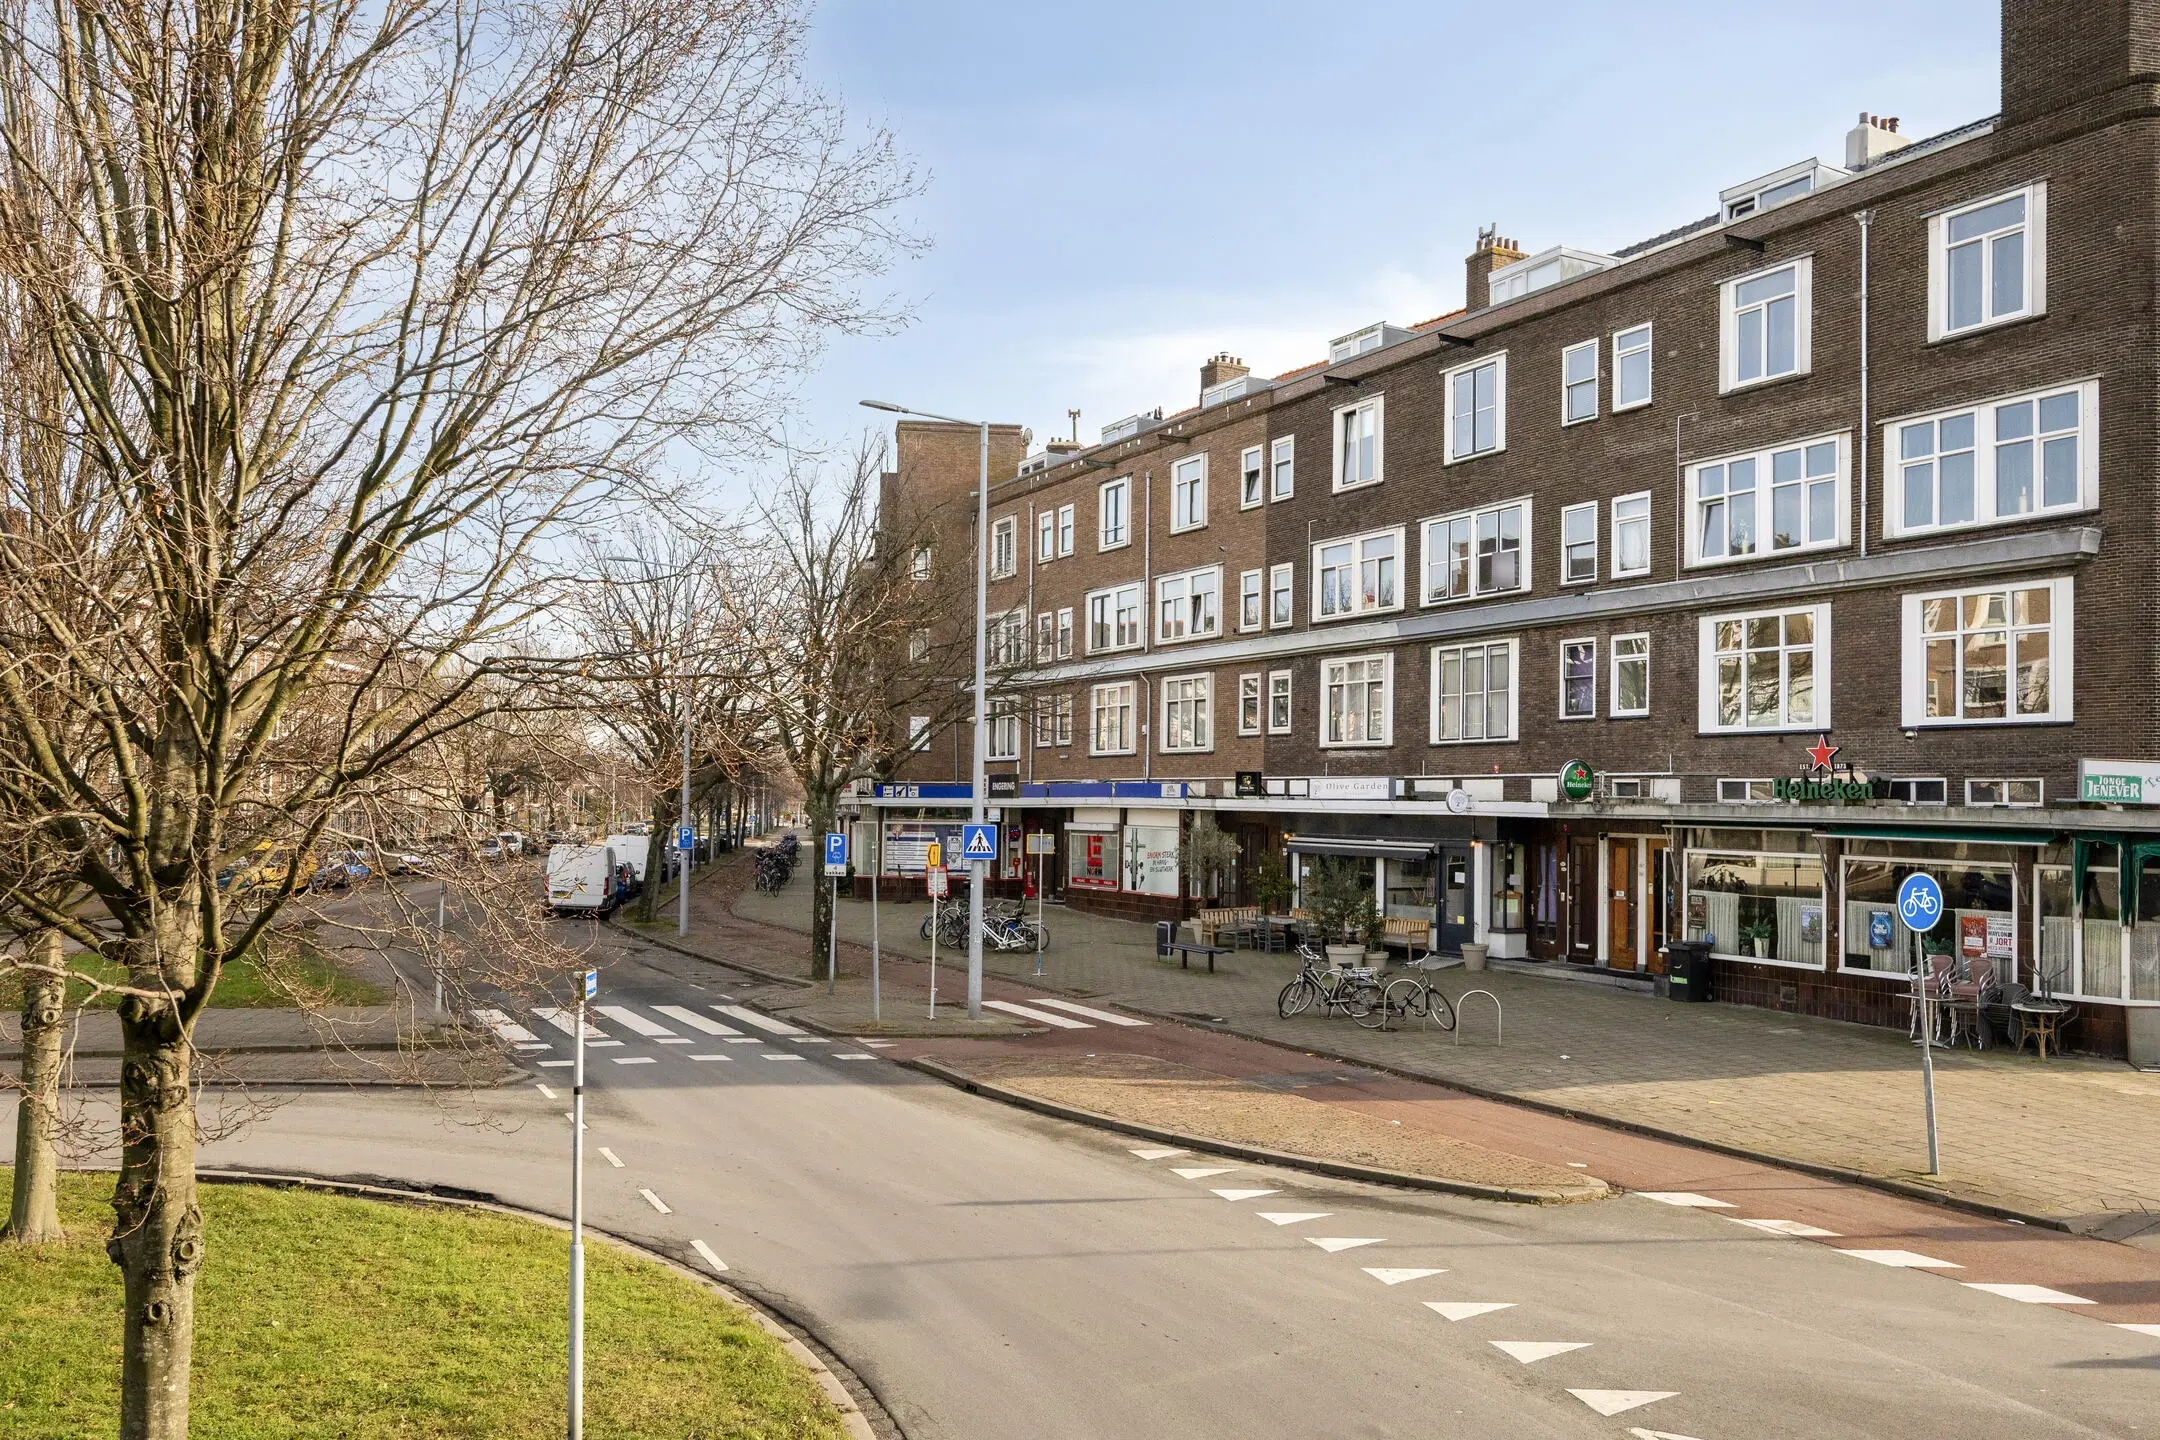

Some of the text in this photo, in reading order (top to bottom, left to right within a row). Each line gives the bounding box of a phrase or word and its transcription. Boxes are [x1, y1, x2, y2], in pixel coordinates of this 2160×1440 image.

[992, 782, 1015, 790] ENGERING
[1353, 782, 1388, 790] Garden
[1773, 777, 1873, 801] Heineken
[2086, 780, 2140, 798] JENEVER
[682, 829, 690, 840] P
[831, 837, 842, 852] P
[1994, 938, 2012, 946] JORT
